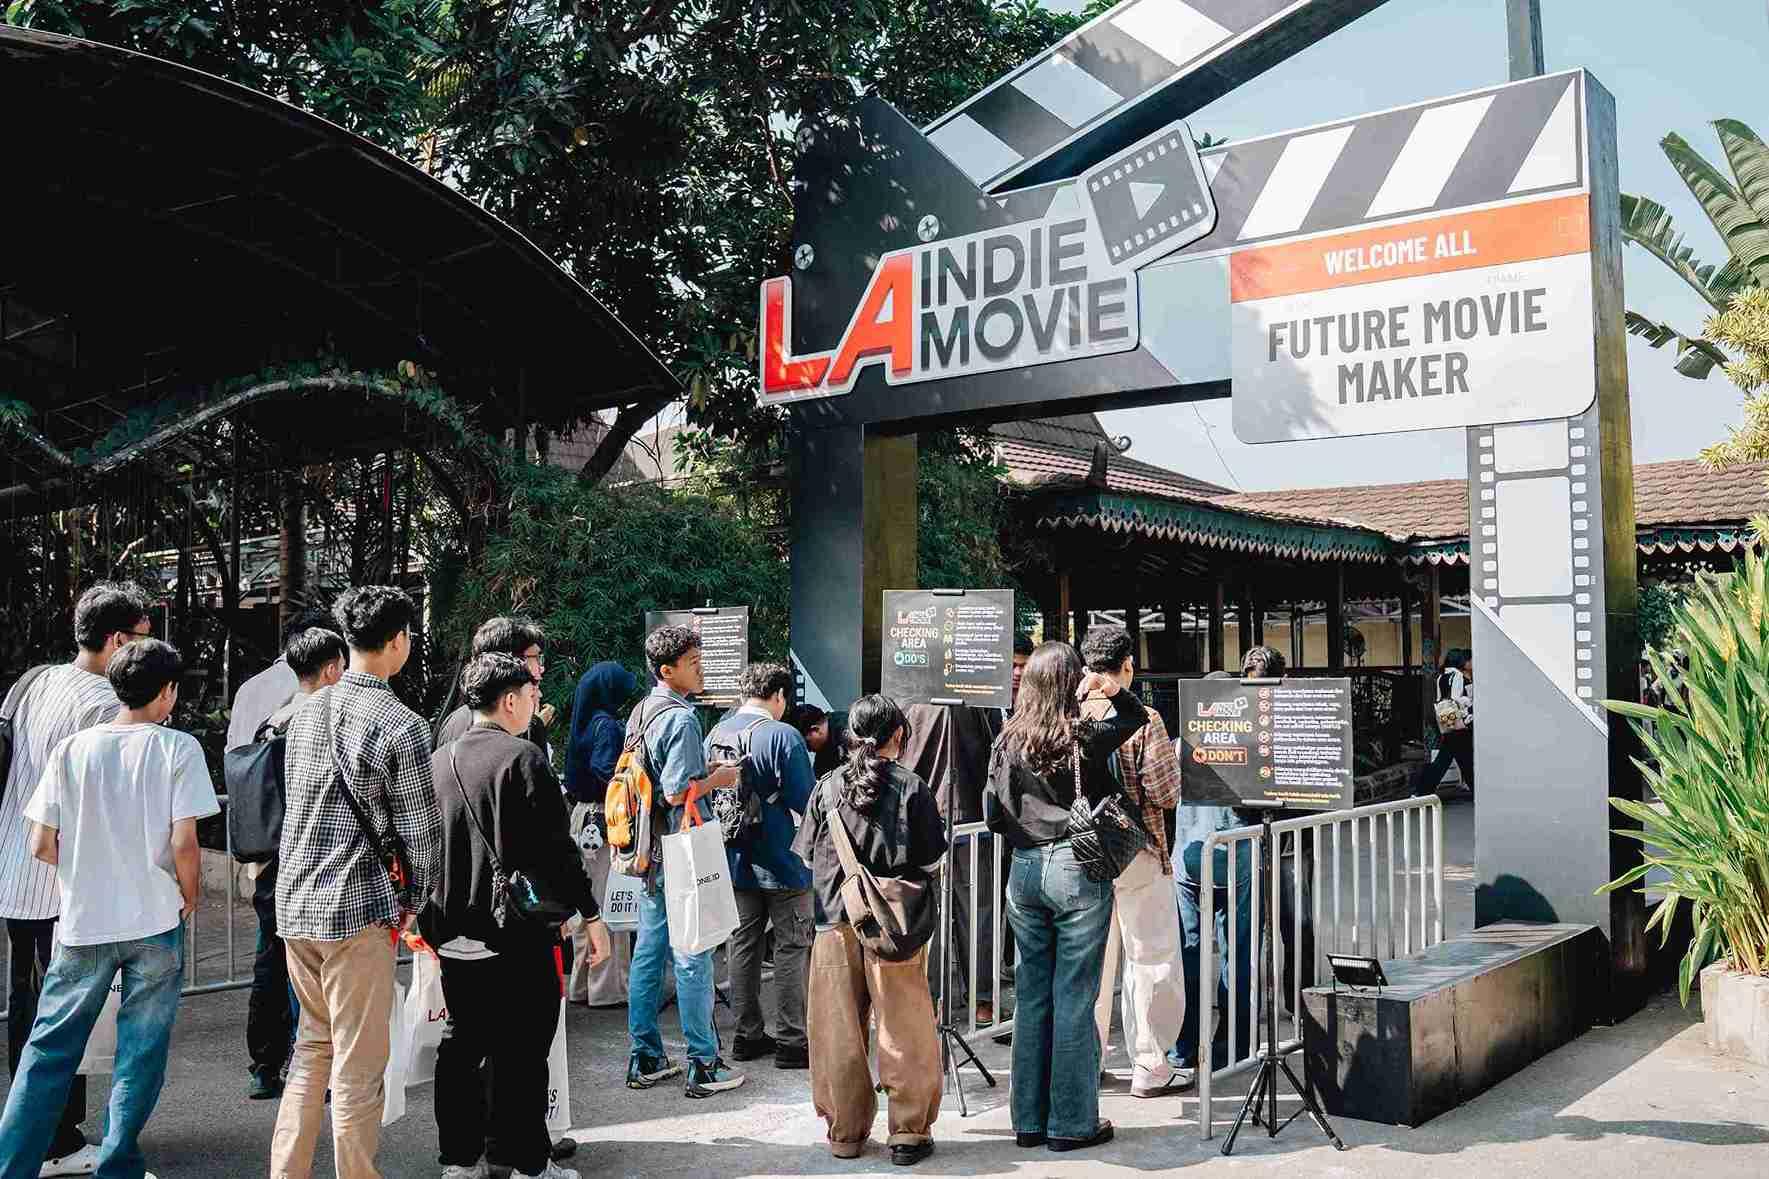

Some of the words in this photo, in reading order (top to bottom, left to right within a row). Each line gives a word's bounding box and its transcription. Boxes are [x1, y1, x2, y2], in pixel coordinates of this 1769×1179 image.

[1325, 237, 1428, 276] WELCOME
[1434, 230, 1477, 258] ALL
[921, 219, 1087, 308] INDIE
[765, 252, 912, 393] LA
[921, 277, 1129, 371] MOVIE
[1268, 306, 1410, 362] FUTURE
[1423, 288, 1547, 343] MOVIE
[1338, 352, 1469, 404] MAKER
[890, 627, 938, 638] CHECKING
[901, 639, 927, 648] AREA
[905, 654, 926, 664] DO'S
[1188, 720, 1252, 732] CHECKING
[1203, 733, 1237, 744] AREA
[1206, 751, 1244, 762] DON'T
[611, 891, 633, 901] LET'S
[611, 902, 623, 912] DO
